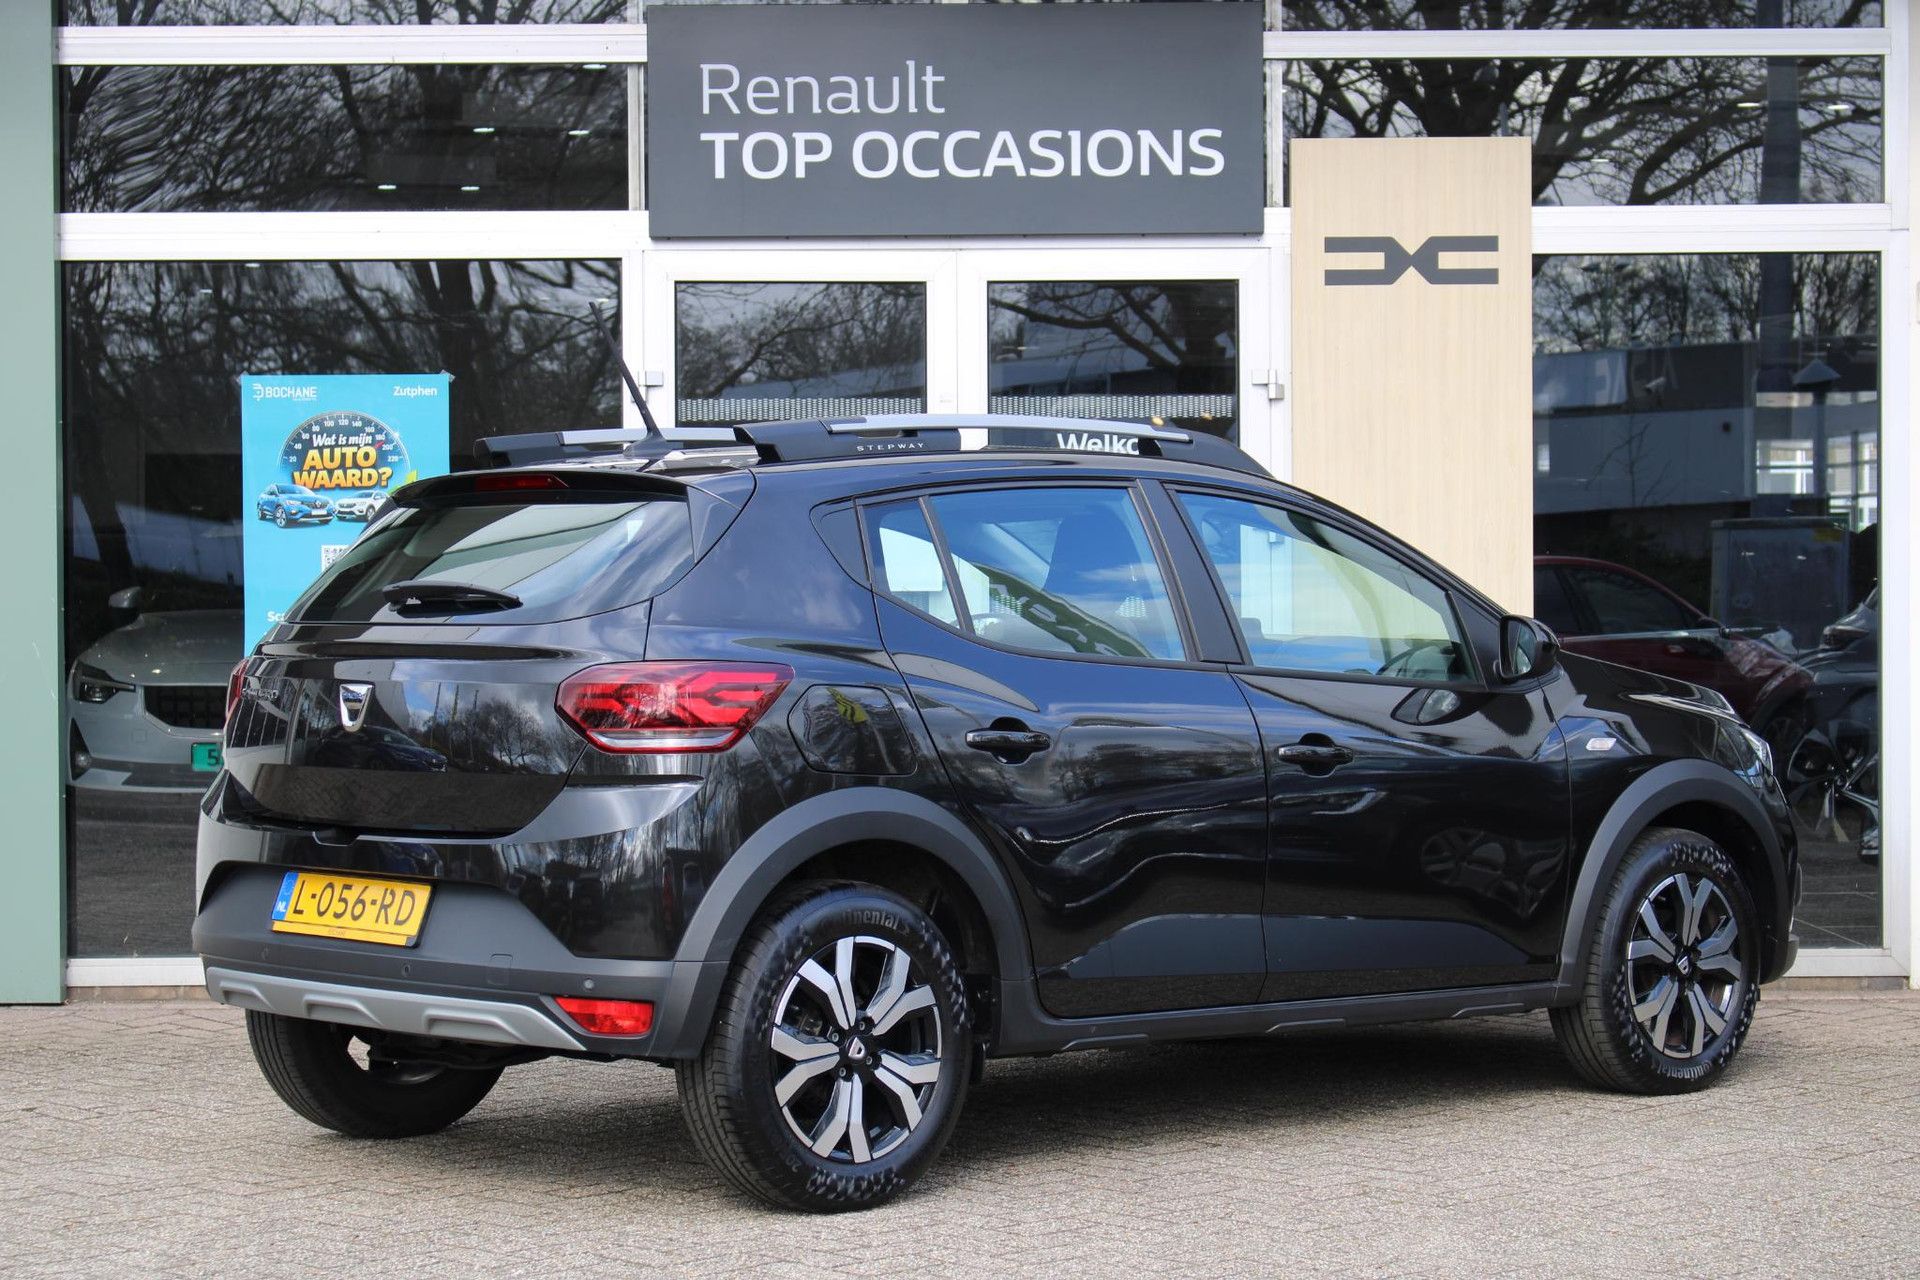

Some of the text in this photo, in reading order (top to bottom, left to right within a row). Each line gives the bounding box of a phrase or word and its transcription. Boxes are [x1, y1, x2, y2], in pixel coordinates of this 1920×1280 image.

[699, 60, 946, 115] Renault
[699, 128, 1226, 180] TOP OCCASIONS
[265, 386, 317, 398] BOCHANE
[393, 385, 437, 398] Zutphen
[312, 433, 372, 447] Wat is mijn
[856, 442, 924, 452] STEPWAY
[303, 446, 377, 471] AUTO
[293, 467, 393, 489] WAARD?
[276, 900, 288, 913] NL
[292, 879, 416, 926] L-056-RD
